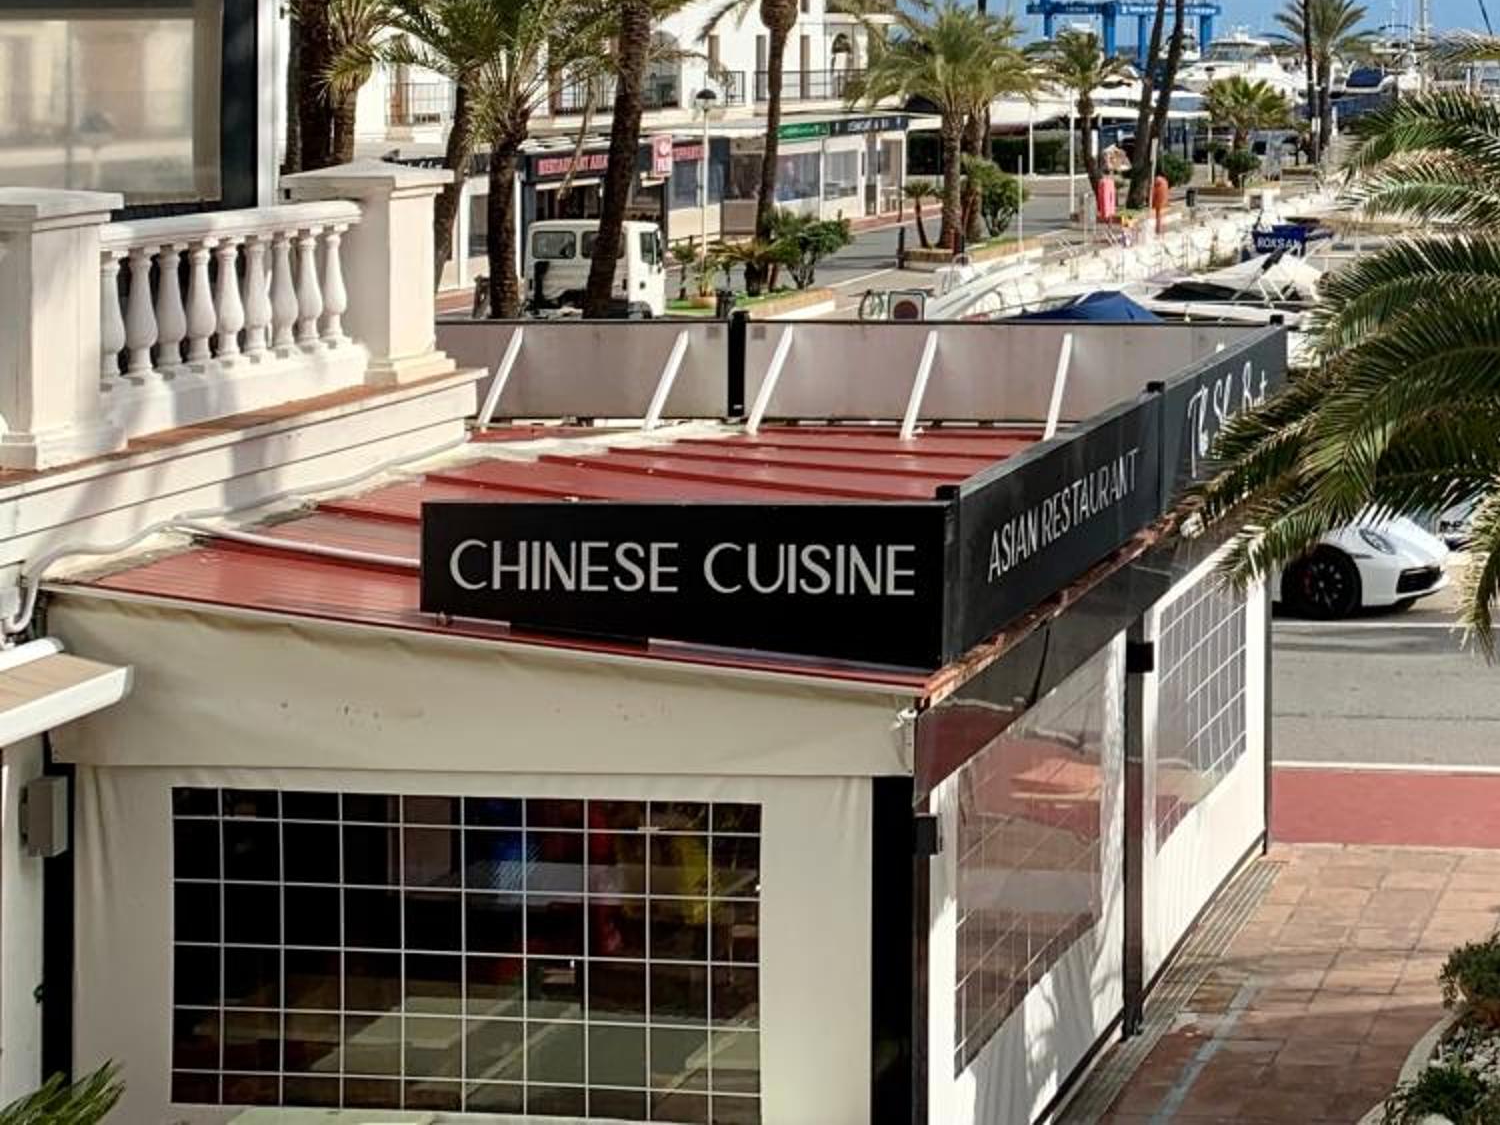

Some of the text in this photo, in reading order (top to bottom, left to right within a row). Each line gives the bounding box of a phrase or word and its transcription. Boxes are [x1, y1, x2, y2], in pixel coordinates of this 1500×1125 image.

[987, 447, 1139, 583] ASIAN RESTAURANT
[449, 539, 916, 596] CHINESE CUISINE
